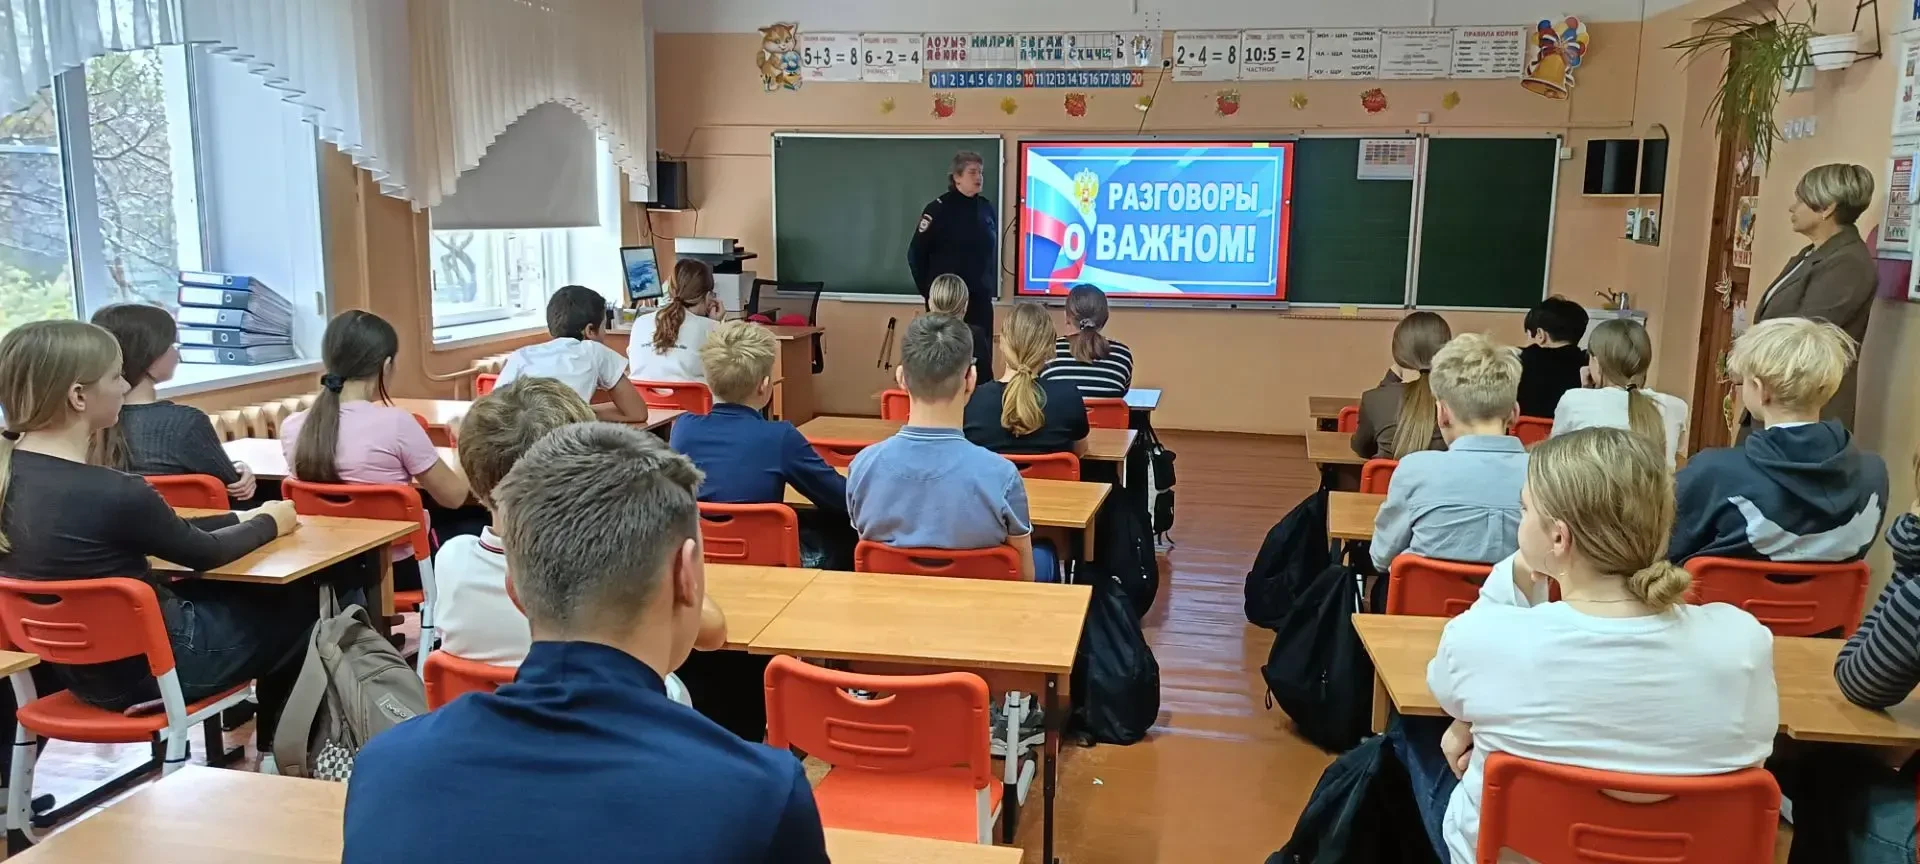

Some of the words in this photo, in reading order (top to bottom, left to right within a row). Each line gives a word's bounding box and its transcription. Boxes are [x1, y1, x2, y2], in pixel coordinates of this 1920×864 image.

[804, 48, 831, 66] 5+3
[836, 53, 845, 62] =
[850, 48, 858, 66] 8
[864, 50, 873, 64] 6
[886, 50, 894, 64] 2
[911, 50, 920, 64] 4
[1177, 45, 1185, 64] 2
[1198, 46, 1206, 64] 4
[1212, 52, 1222, 60] =
[1228, 45, 1236, 64] 8
[1245, 47, 1276, 62] 10:5
[1281, 50, 1291, 58] =
[1296, 46, 1305, 61] 2
[932, 74, 938, 86] 0
[940, 74, 946, 86] 1
[950, 74, 956, 86] 2
[959, 74, 965, 86] 3
[968, 74, 974, 86] 4
[978, 74, 984, 86] 5
[988, 74, 994, 86] 6
[996, 74, 1002, 86] 7
[1006, 74, 1012, 86] 8
[1016, 74, 1022, 86] 9
[1024, 74, 1034, 86] 10
[1036, 72, 1044, 85] 11
[1046, 72, 1054, 85] 12
[1056, 72, 1066, 85] 13
[1068, 72, 1077, 85] 14
[1080, 72, 1088, 85] 15
[1090, 72, 1098, 85] 16
[1100, 72, 1109, 85] 17
[1110, 72, 1120, 85] 18
[1122, 72, 1131, 85] 19
[1132, 72, 1142, 85] 20
[1108, 182, 1258, 212] РАЗГОВОРЫ
[1063, 223, 1086, 260] О
[1096, 224, 1256, 264] ВАЖНОМ!
